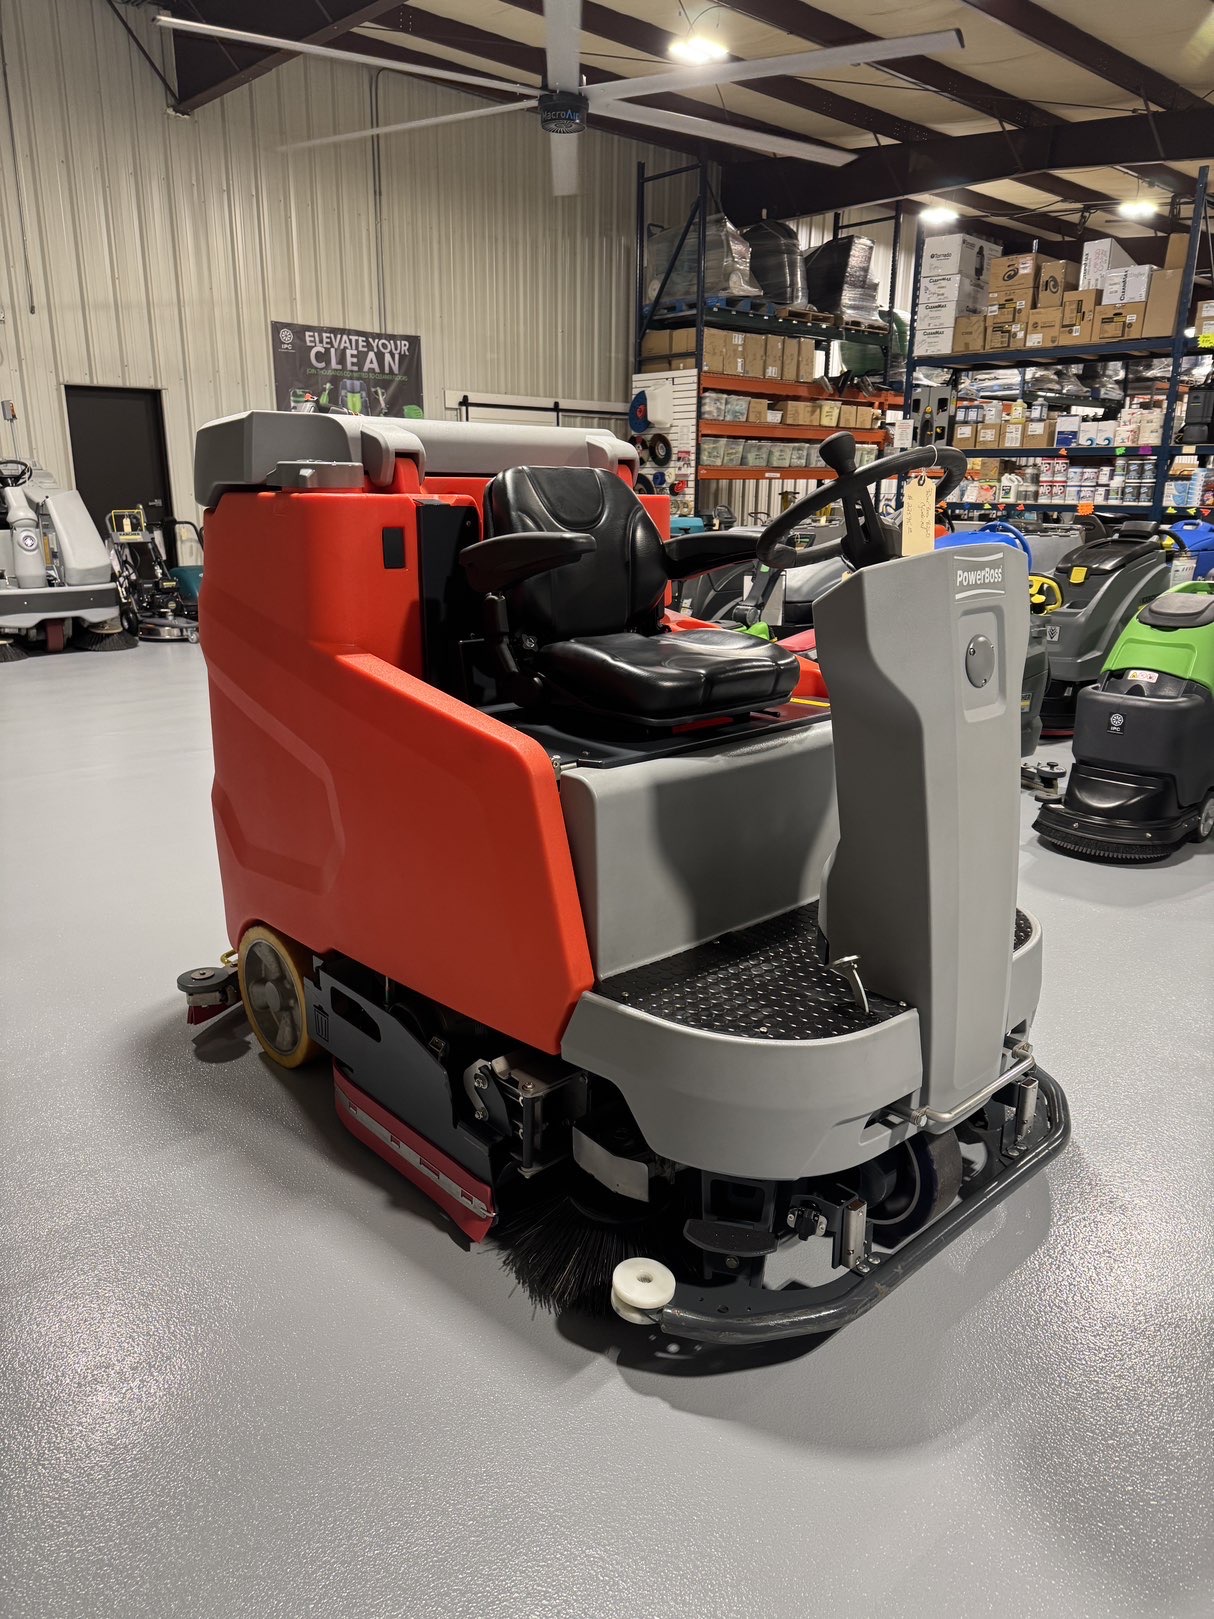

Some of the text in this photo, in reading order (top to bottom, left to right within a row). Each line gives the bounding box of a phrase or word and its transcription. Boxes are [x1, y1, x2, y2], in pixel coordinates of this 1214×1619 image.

[305, 331, 409, 355] ELEVATE YOUR
[310, 346, 400, 374] CLEAN
[957, 567, 1002, 586] PowerBoss
